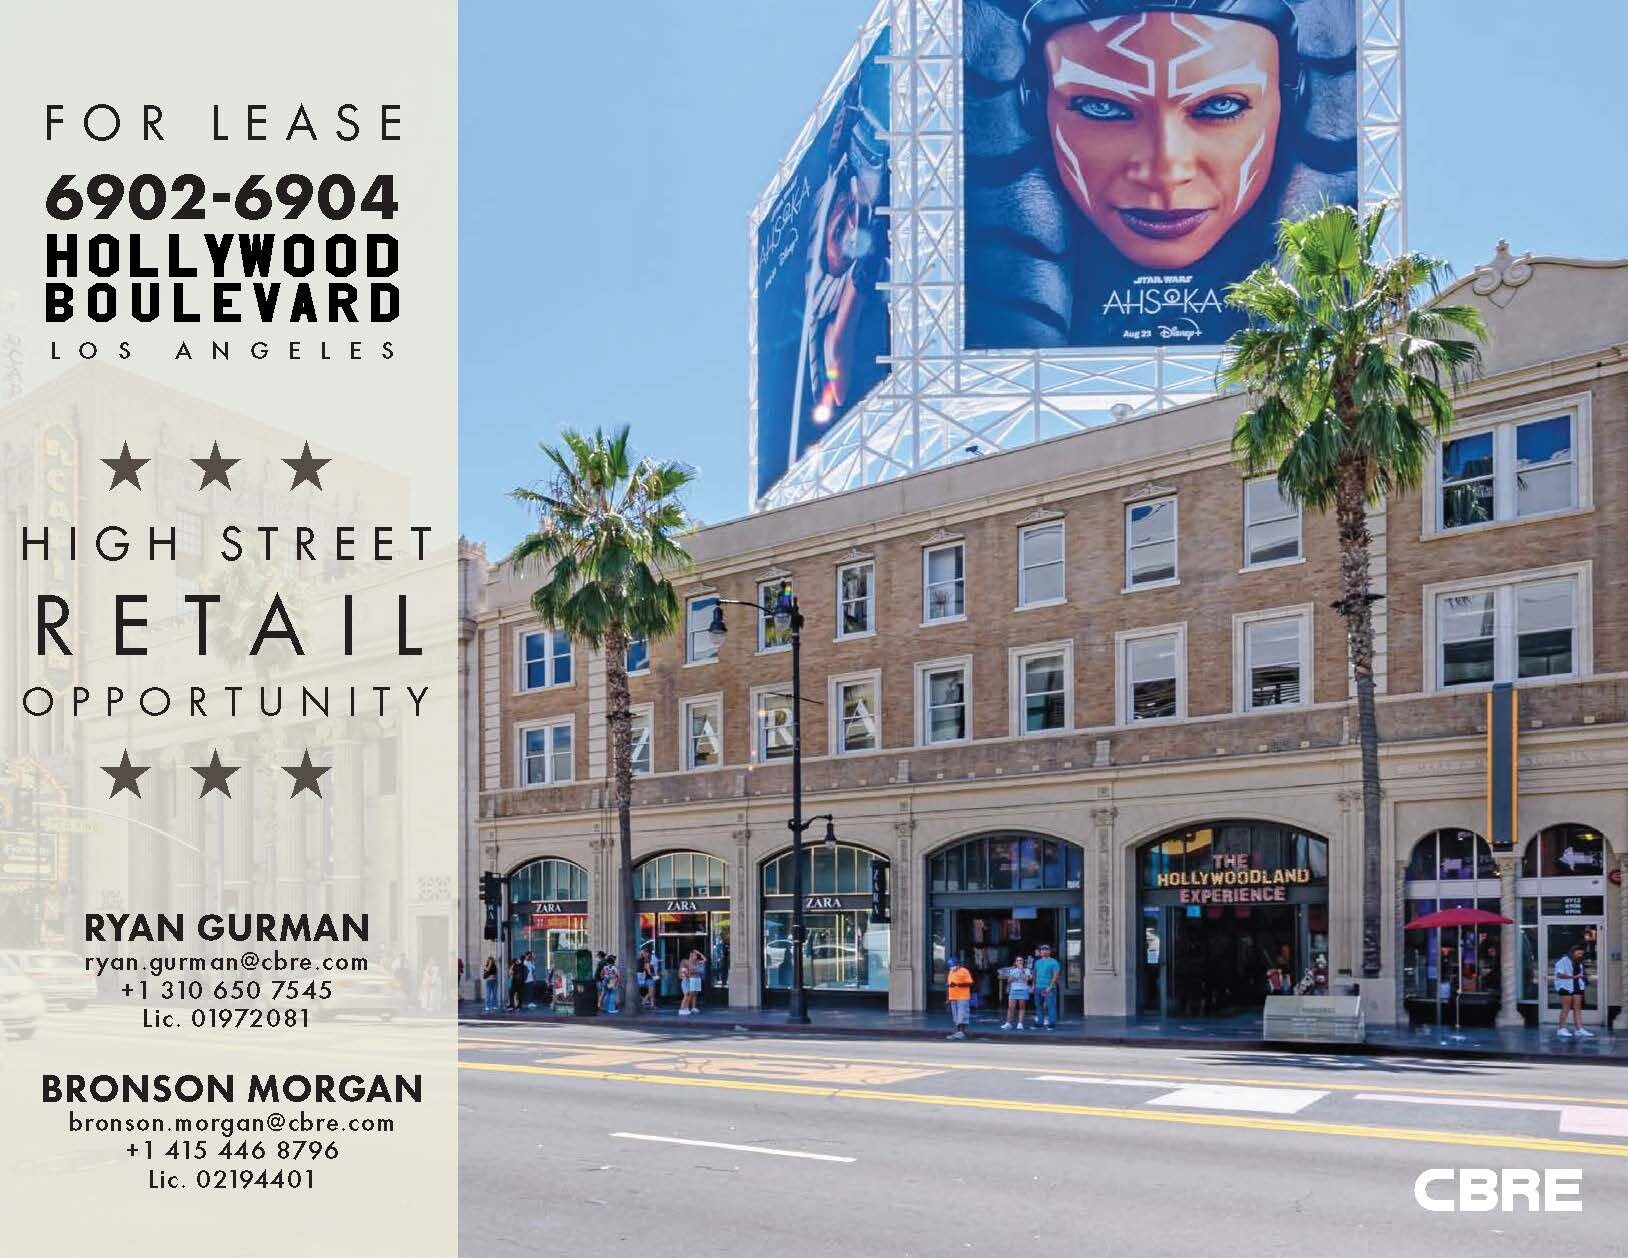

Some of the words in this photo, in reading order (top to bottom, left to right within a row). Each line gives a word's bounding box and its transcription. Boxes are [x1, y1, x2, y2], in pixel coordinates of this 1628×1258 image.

[1164, 275, 1193, 284] WARS
[1103, 288, 1223, 315] AHSOKA
[1123, 329, 1140, 339] Aug
[1141, 329, 1152, 337] 23
[1213, 853, 1248, 868] THE
[1157, 869, 1311, 887] HOLLYWOODLAND
[1179, 886, 1286, 904] EXPERIENCE
[536, 903, 562, 913] ZARA
[666, 900, 697, 912] ZARA
[805, 897, 842, 909] ZARA
